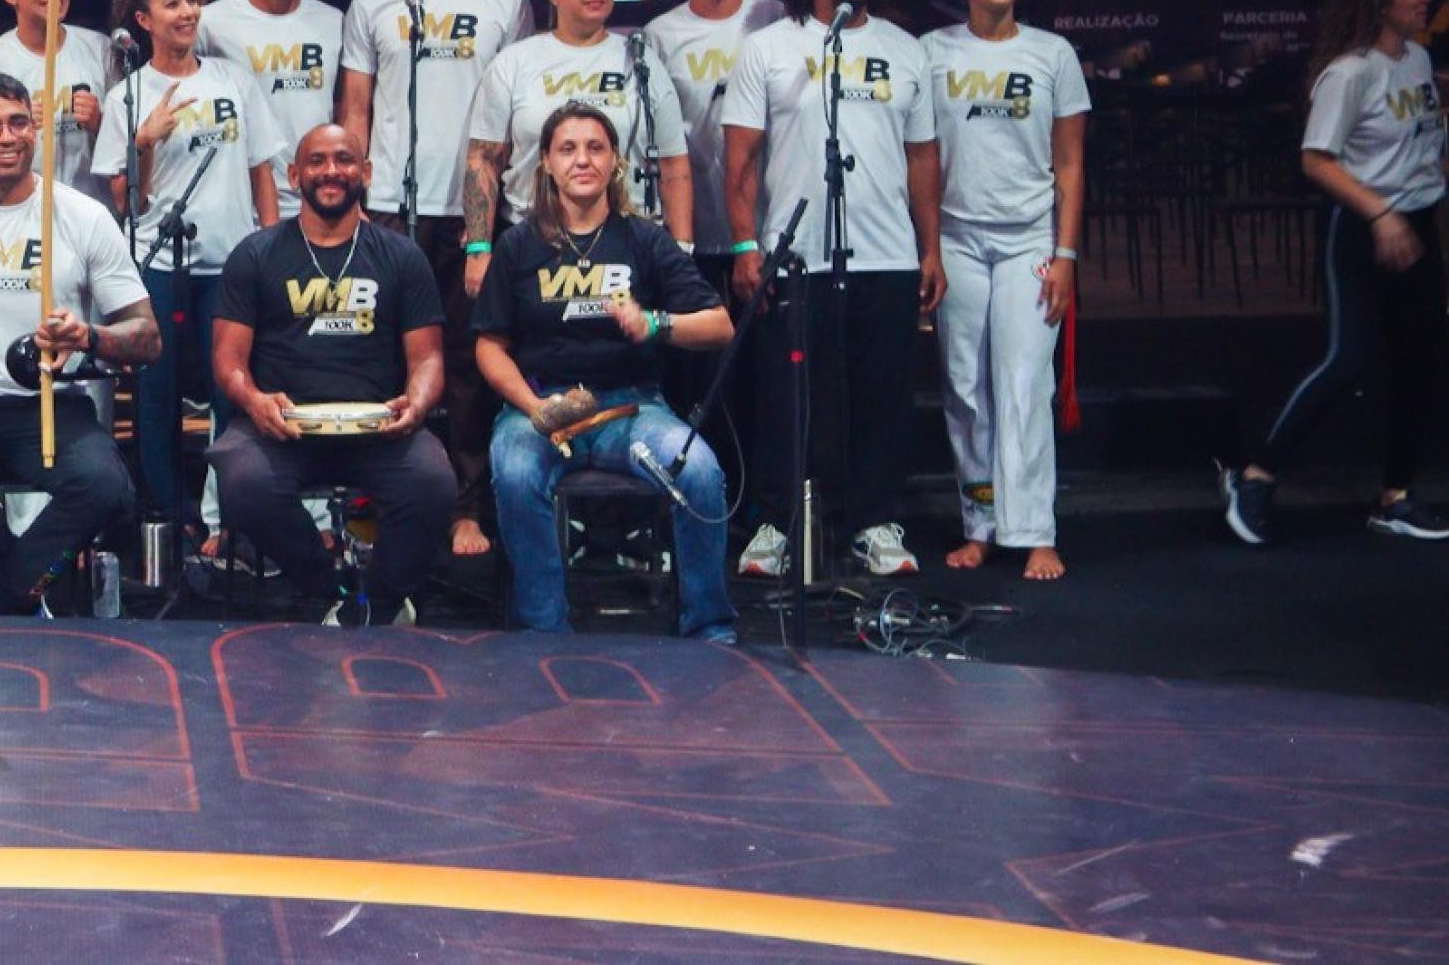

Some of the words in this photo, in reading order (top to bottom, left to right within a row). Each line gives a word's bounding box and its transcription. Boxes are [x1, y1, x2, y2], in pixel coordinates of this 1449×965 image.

[1222, 10, 1308, 25] PARCERIA
[245, 42, 323, 74] VMB
[542, 71, 626, 96] VMB
[946, 70, 1033, 99] VMB
[286, 277, 379, 315] VMB
[536, 264, 632, 300] VMB
[356, 309, 375, 334] 8
